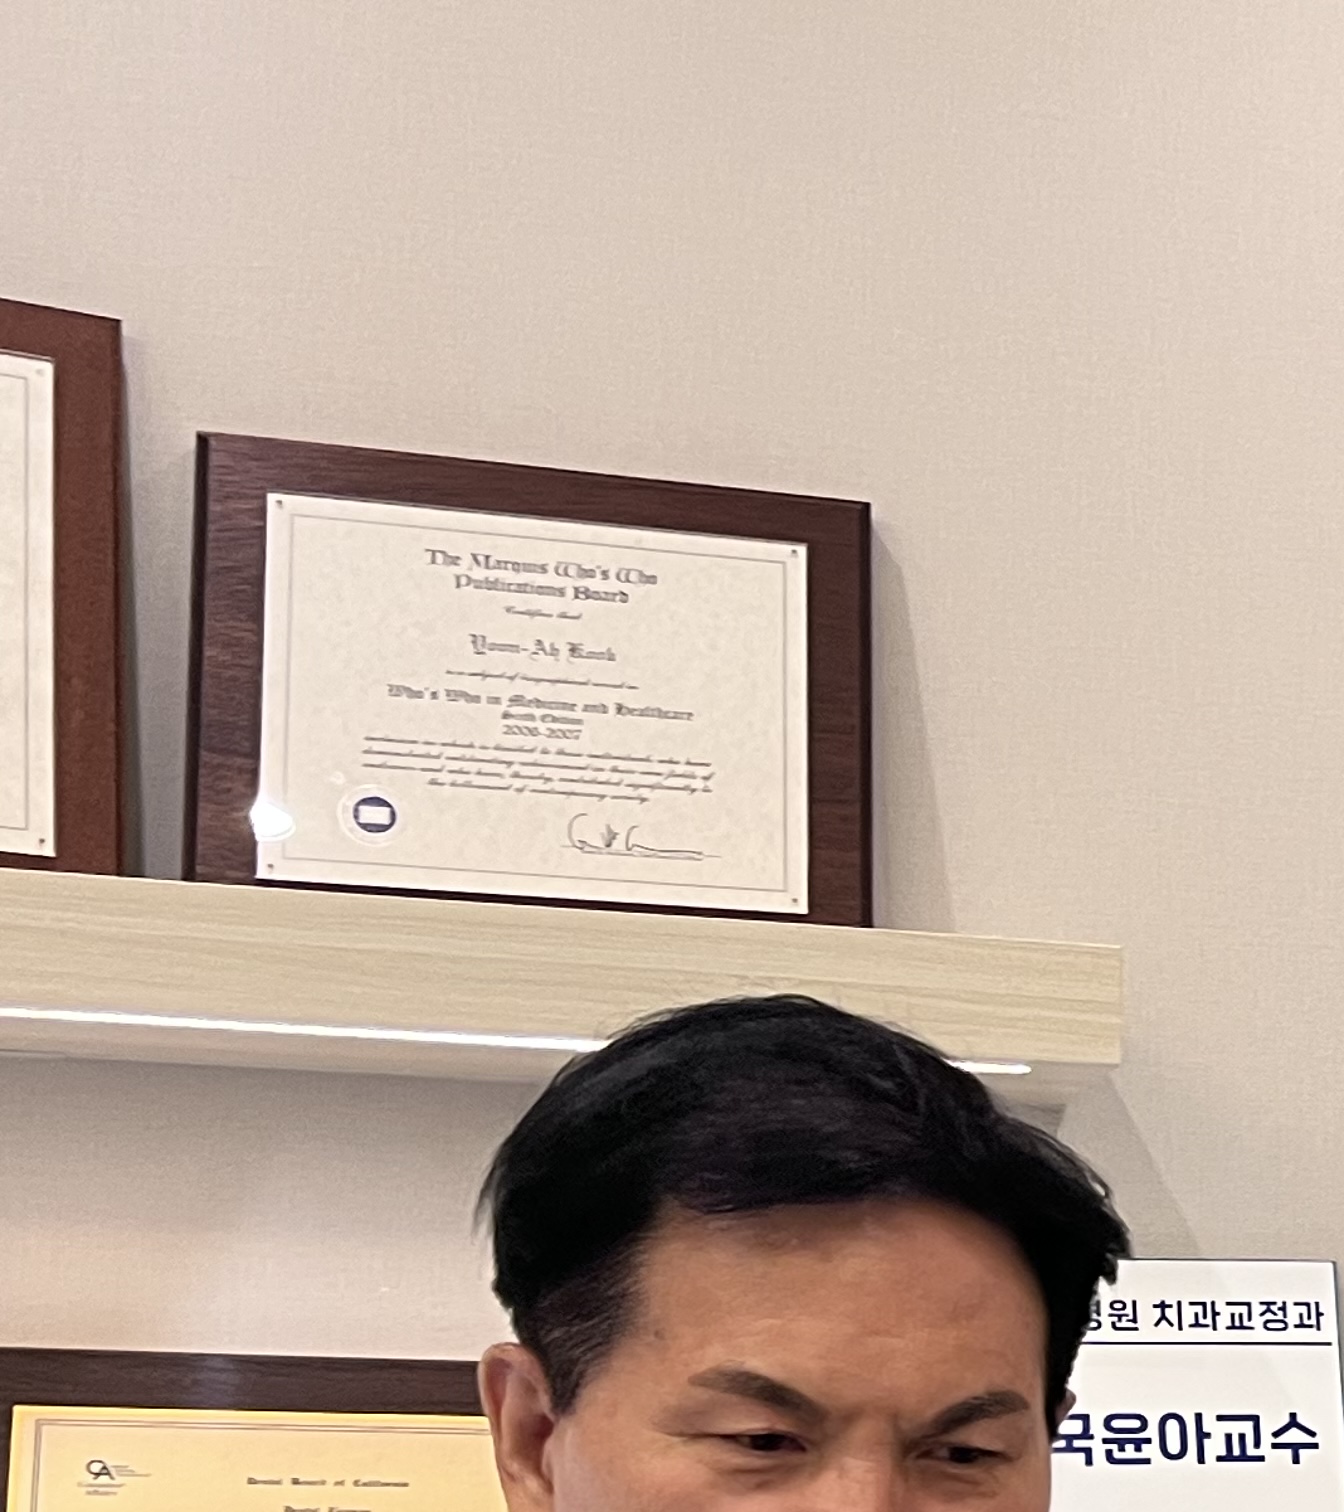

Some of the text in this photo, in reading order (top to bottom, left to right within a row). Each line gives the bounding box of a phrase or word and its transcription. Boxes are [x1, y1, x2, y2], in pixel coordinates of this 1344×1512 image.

[425, 548, 461, 567] The
[1152, 1299, 1325, 1332] 치과교정과
[1052, 1411, 1320, 1467] 국윤아교수
